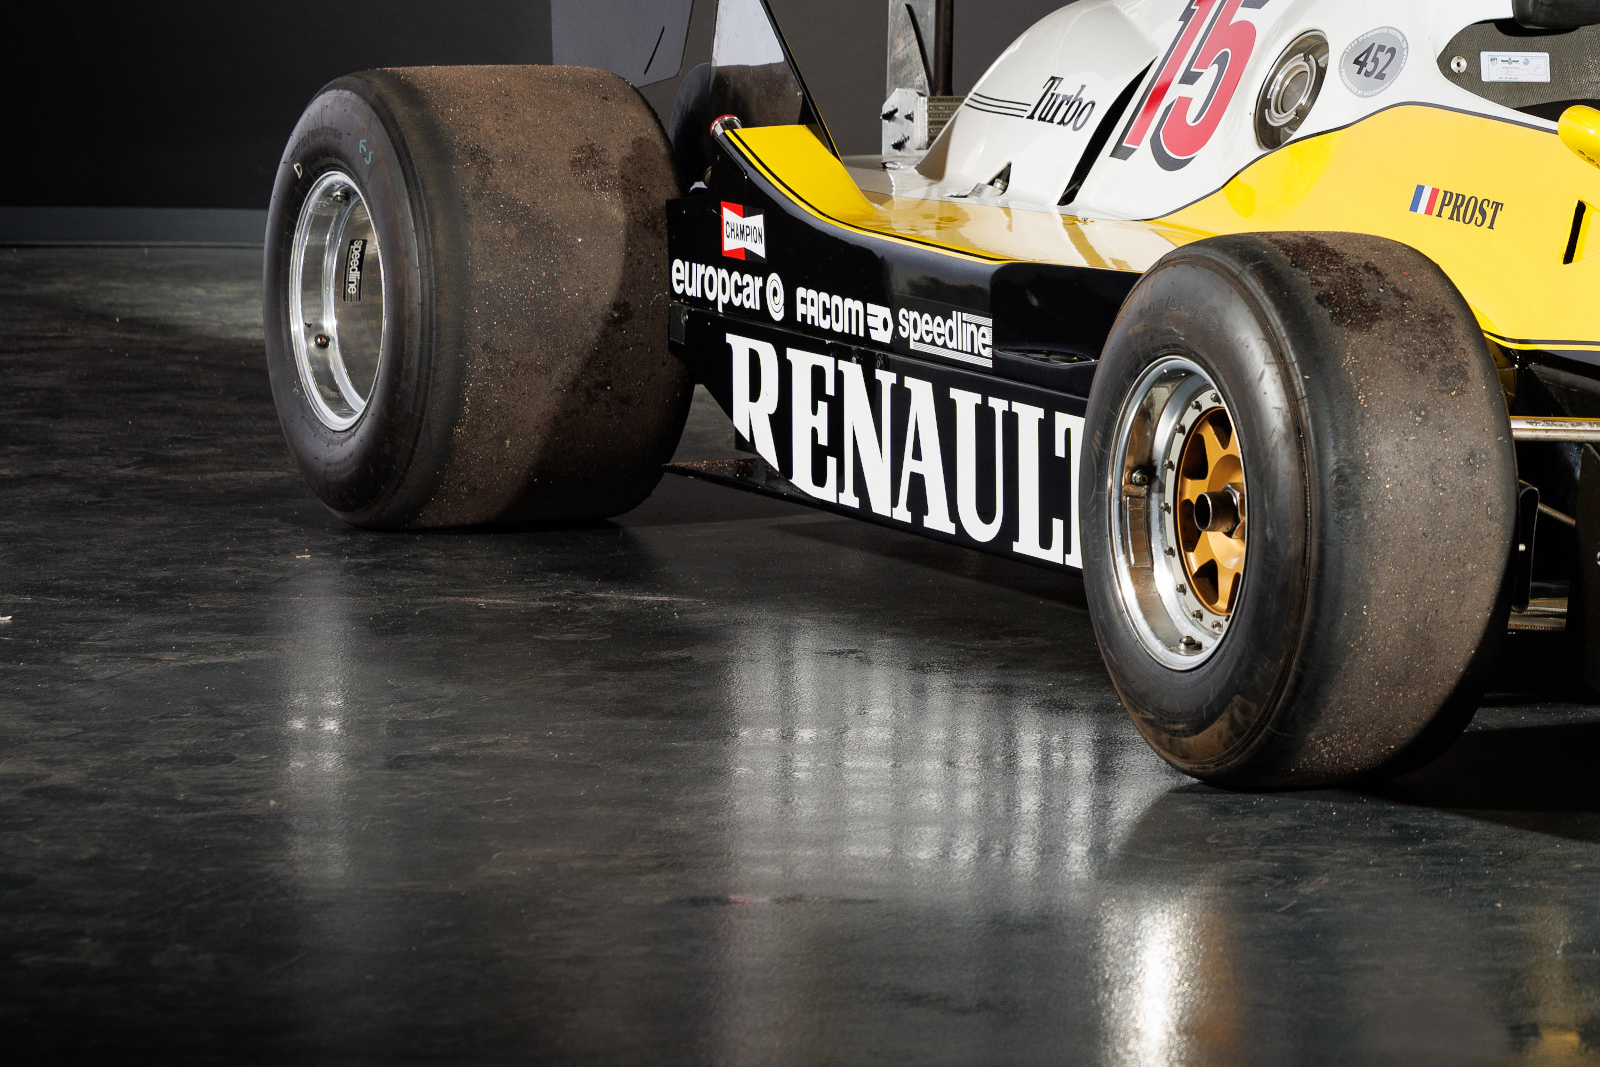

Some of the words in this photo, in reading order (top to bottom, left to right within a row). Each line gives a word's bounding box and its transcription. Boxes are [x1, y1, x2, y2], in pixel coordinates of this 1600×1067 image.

[1352, 42, 1397, 81] 452
[1027, 75, 1096, 132] Turbo
[725, 220, 763, 244] CHAMPION
[1438, 189, 1504, 231] PROST
[347, 239, 363, 295] speedline
[671, 258, 763, 313] europcar
[898, 307, 993, 358] speedline
